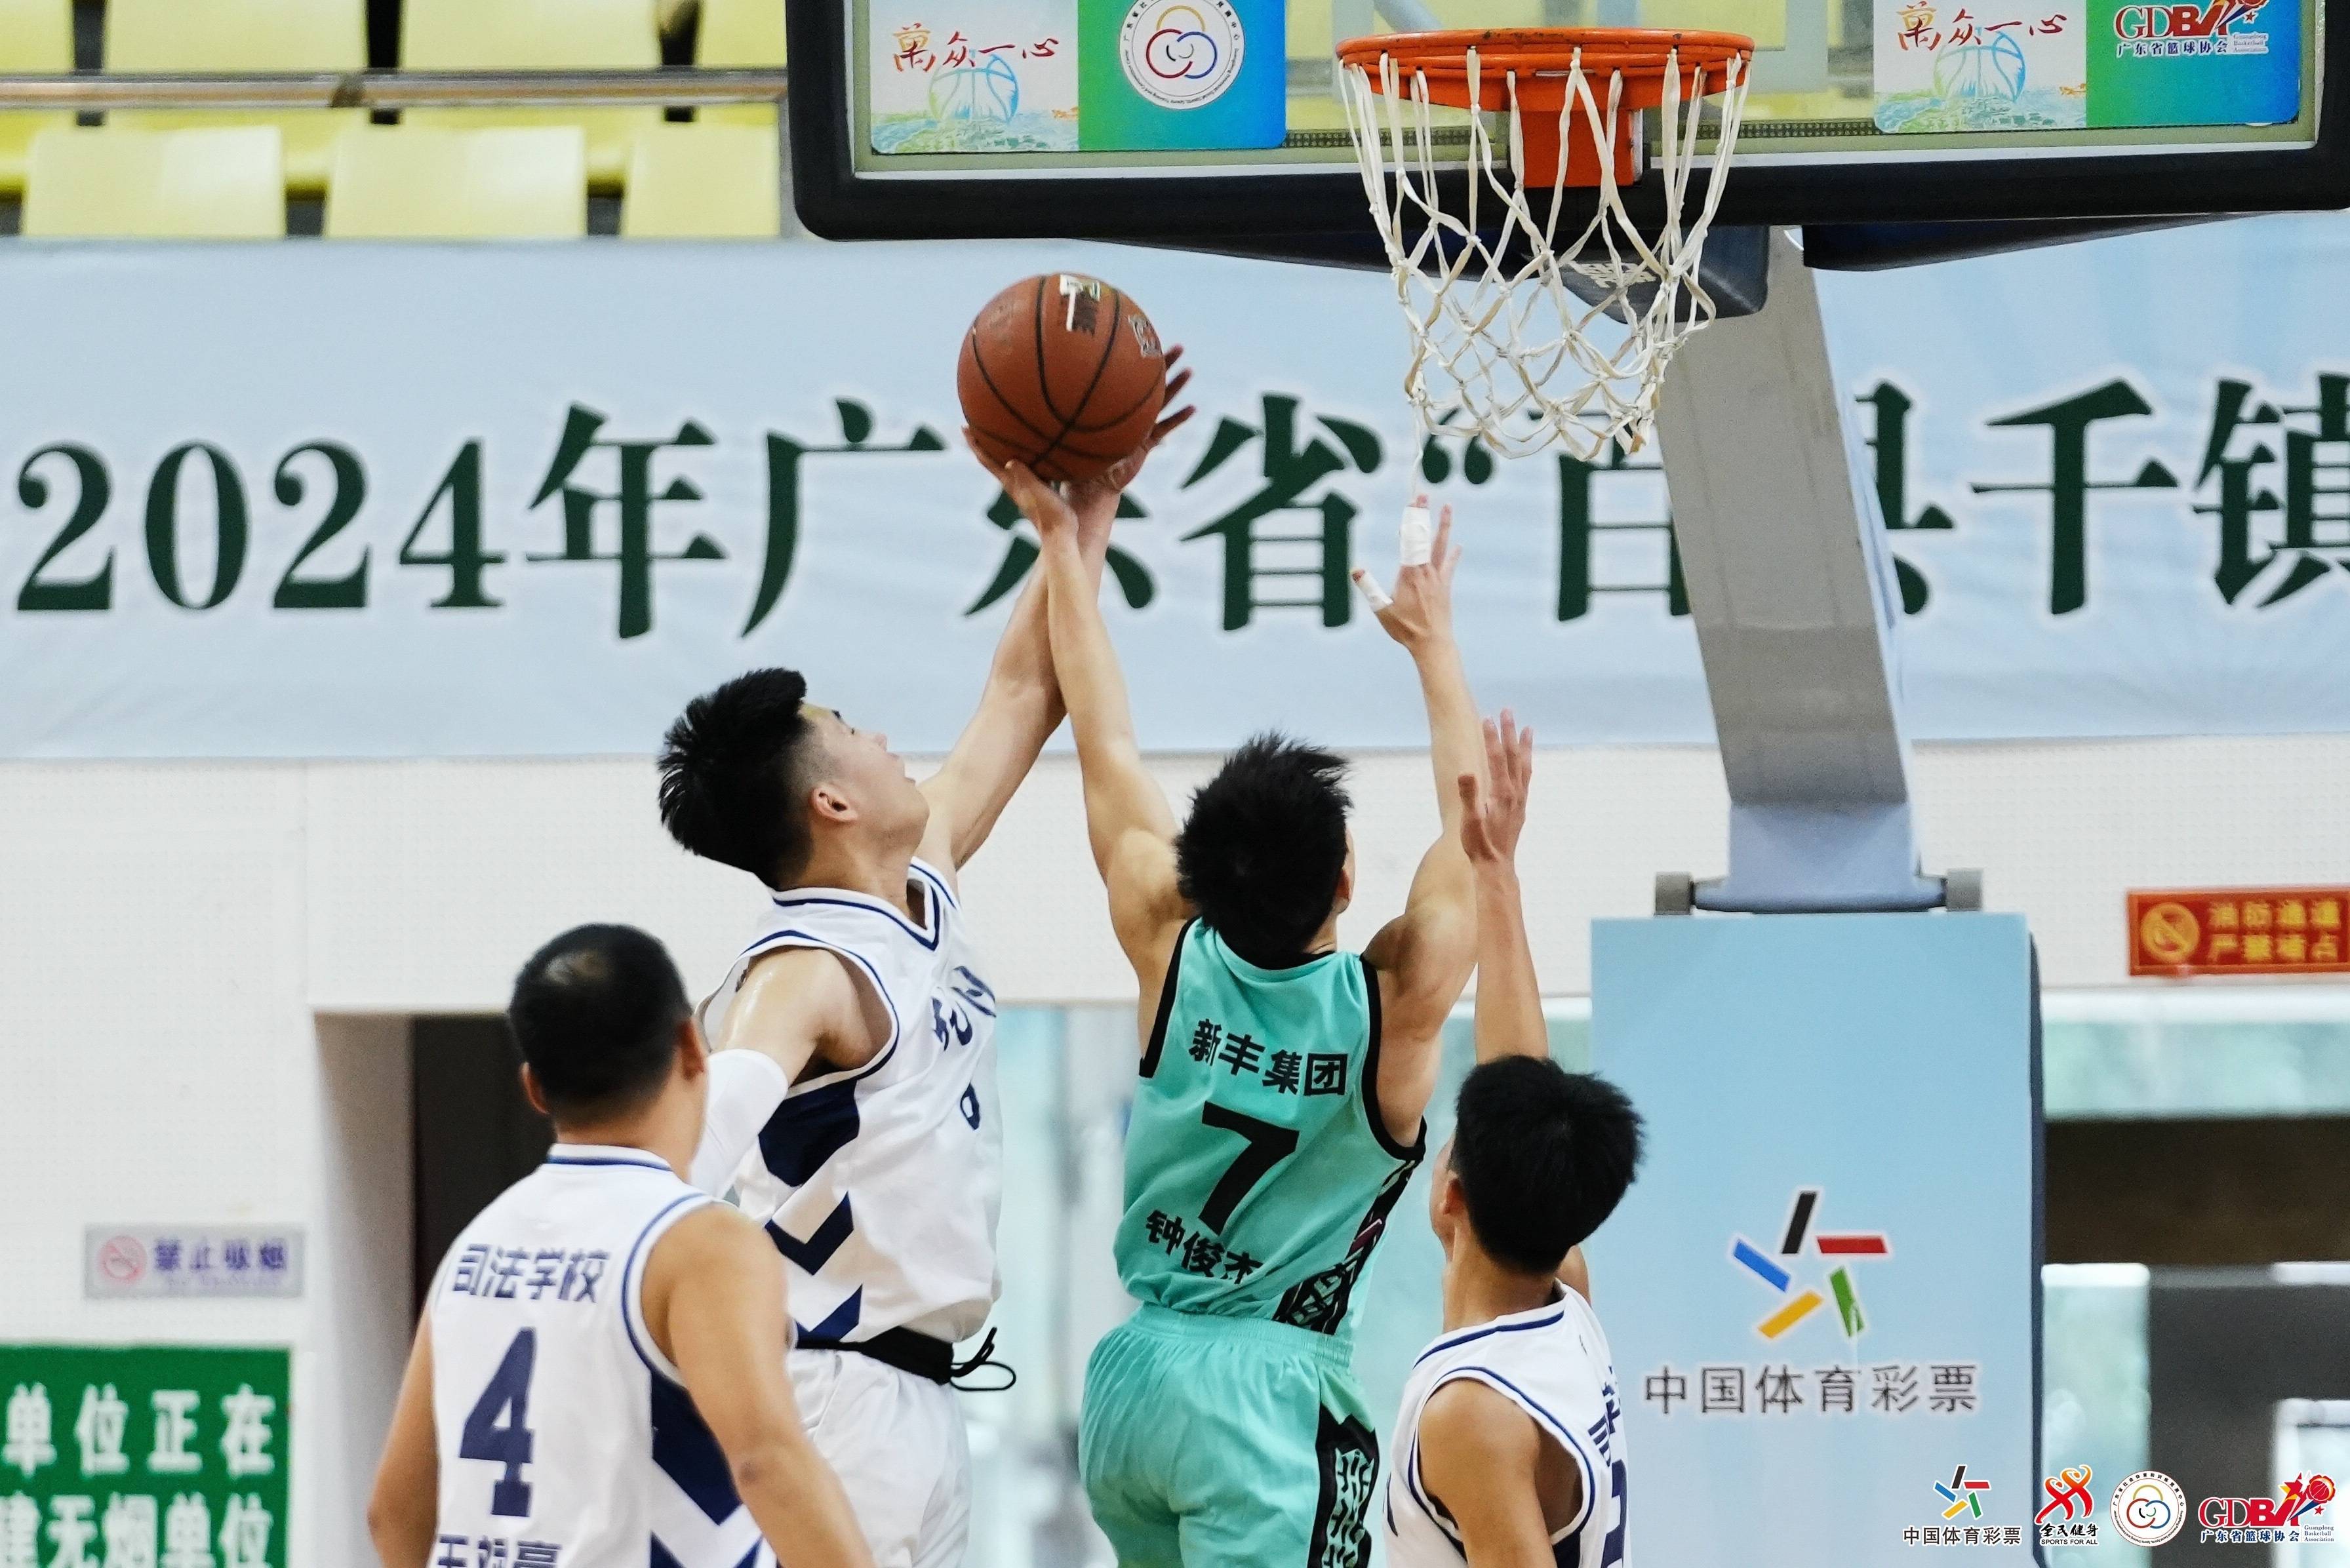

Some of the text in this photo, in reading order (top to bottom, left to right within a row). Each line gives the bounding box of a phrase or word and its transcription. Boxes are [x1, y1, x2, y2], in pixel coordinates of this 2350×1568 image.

[2118, 41, 2229, 56] 广东省篮球协会
[17, 374, 2350, 638] 2024年广省“百千镇
[1188, 1018, 1348, 1097] 新丰集团
[1198, 1101, 1300, 1236] 7
[452, 1243, 611, 1304] 司法学校
[1, 1382, 276, 1480] 单位正在
[458, 1325, 538, 1518] 4
[1645, 1364, 1978, 1414] 中国体育彩票
